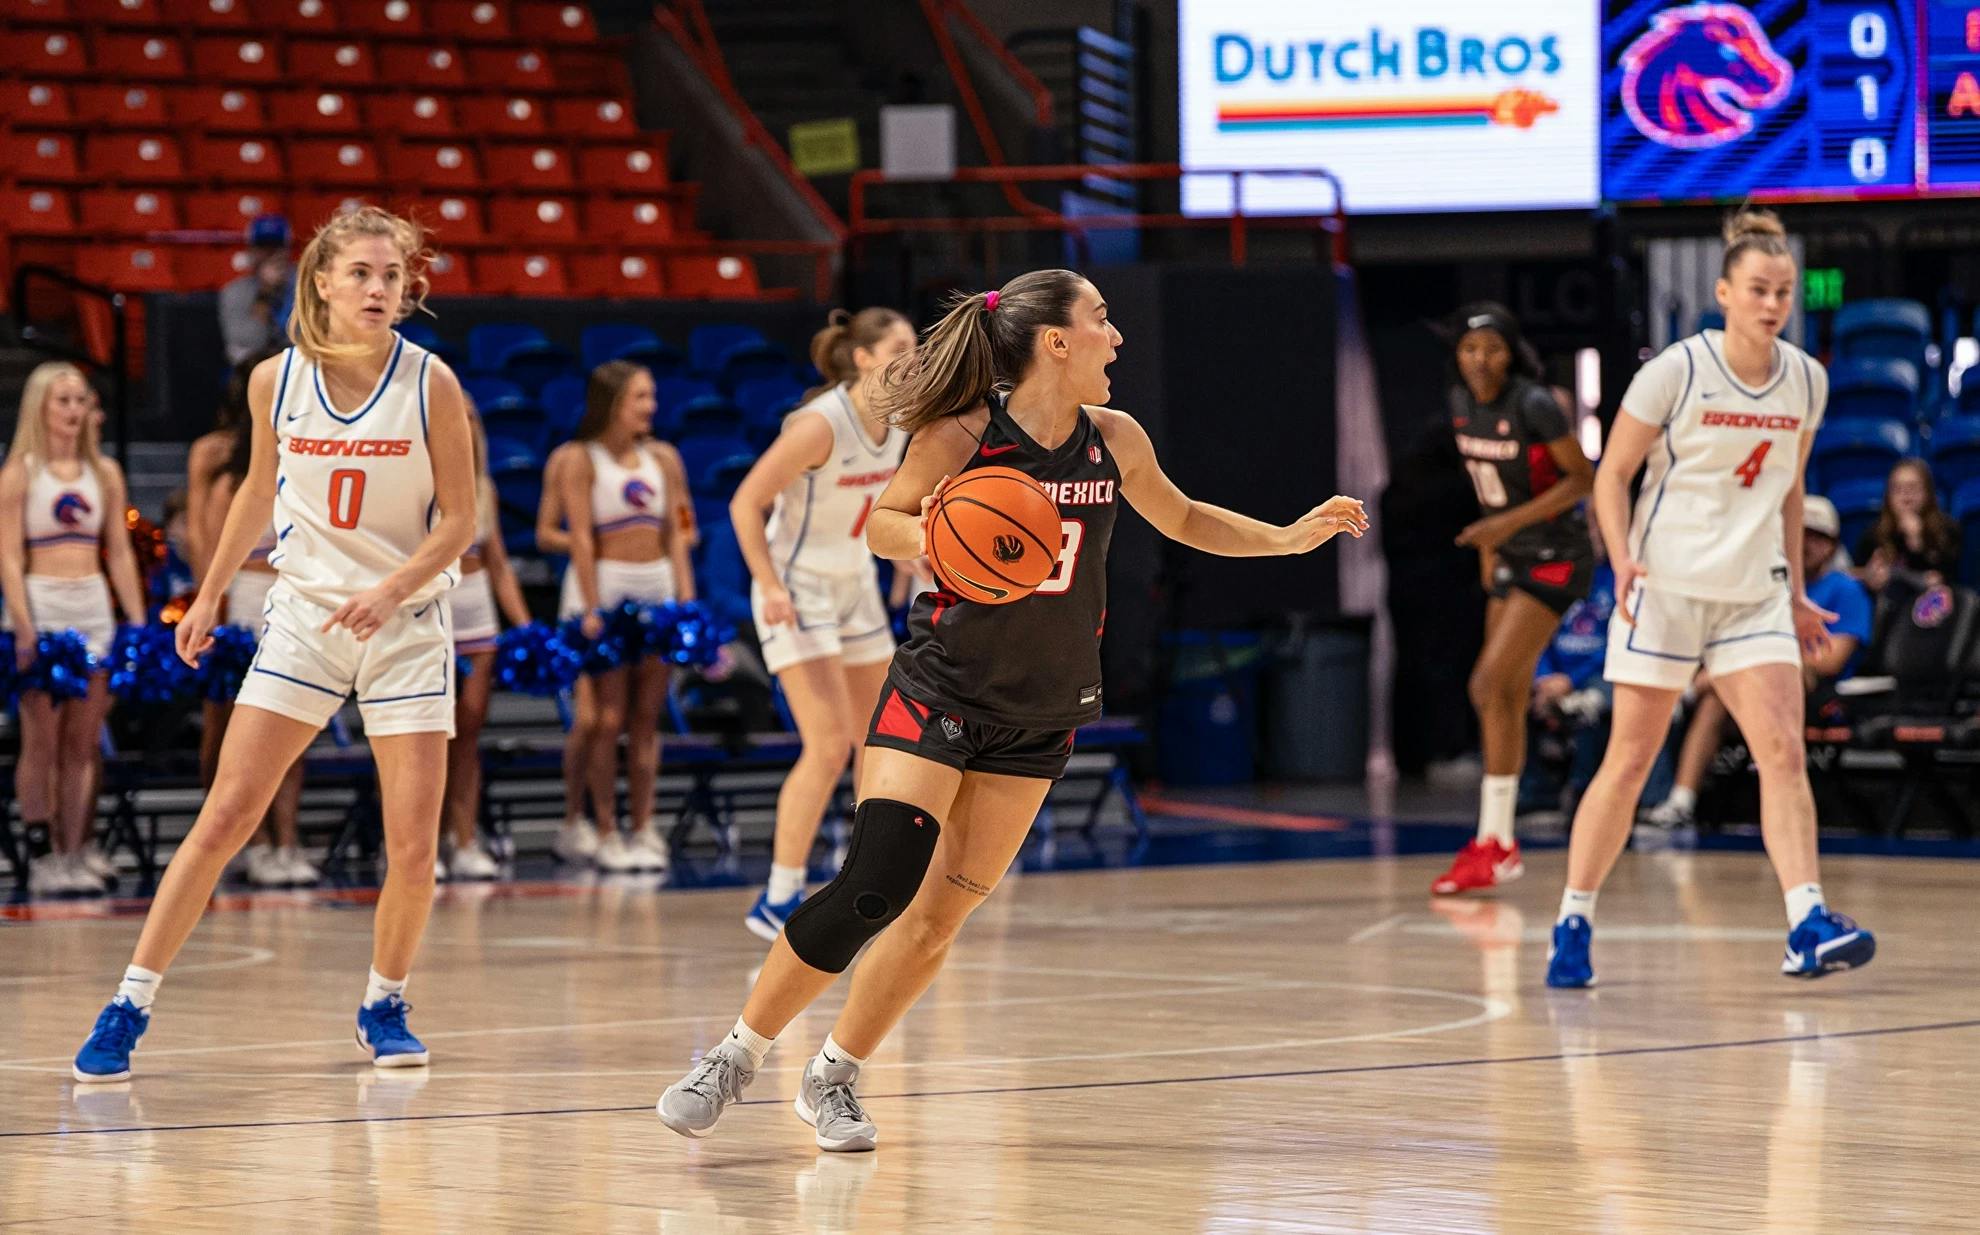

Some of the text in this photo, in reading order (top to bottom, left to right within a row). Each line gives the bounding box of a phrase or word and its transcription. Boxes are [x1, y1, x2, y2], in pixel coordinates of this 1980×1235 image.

[1850, 12, 1887, 59] 0
[1856, 75, 1879, 120] 1
[1850, 138, 1887, 183] 0
[288, 437, 412, 457] BRONCOS
[1734, 440, 1773, 489] 4
[328, 468, 366, 530] 0
